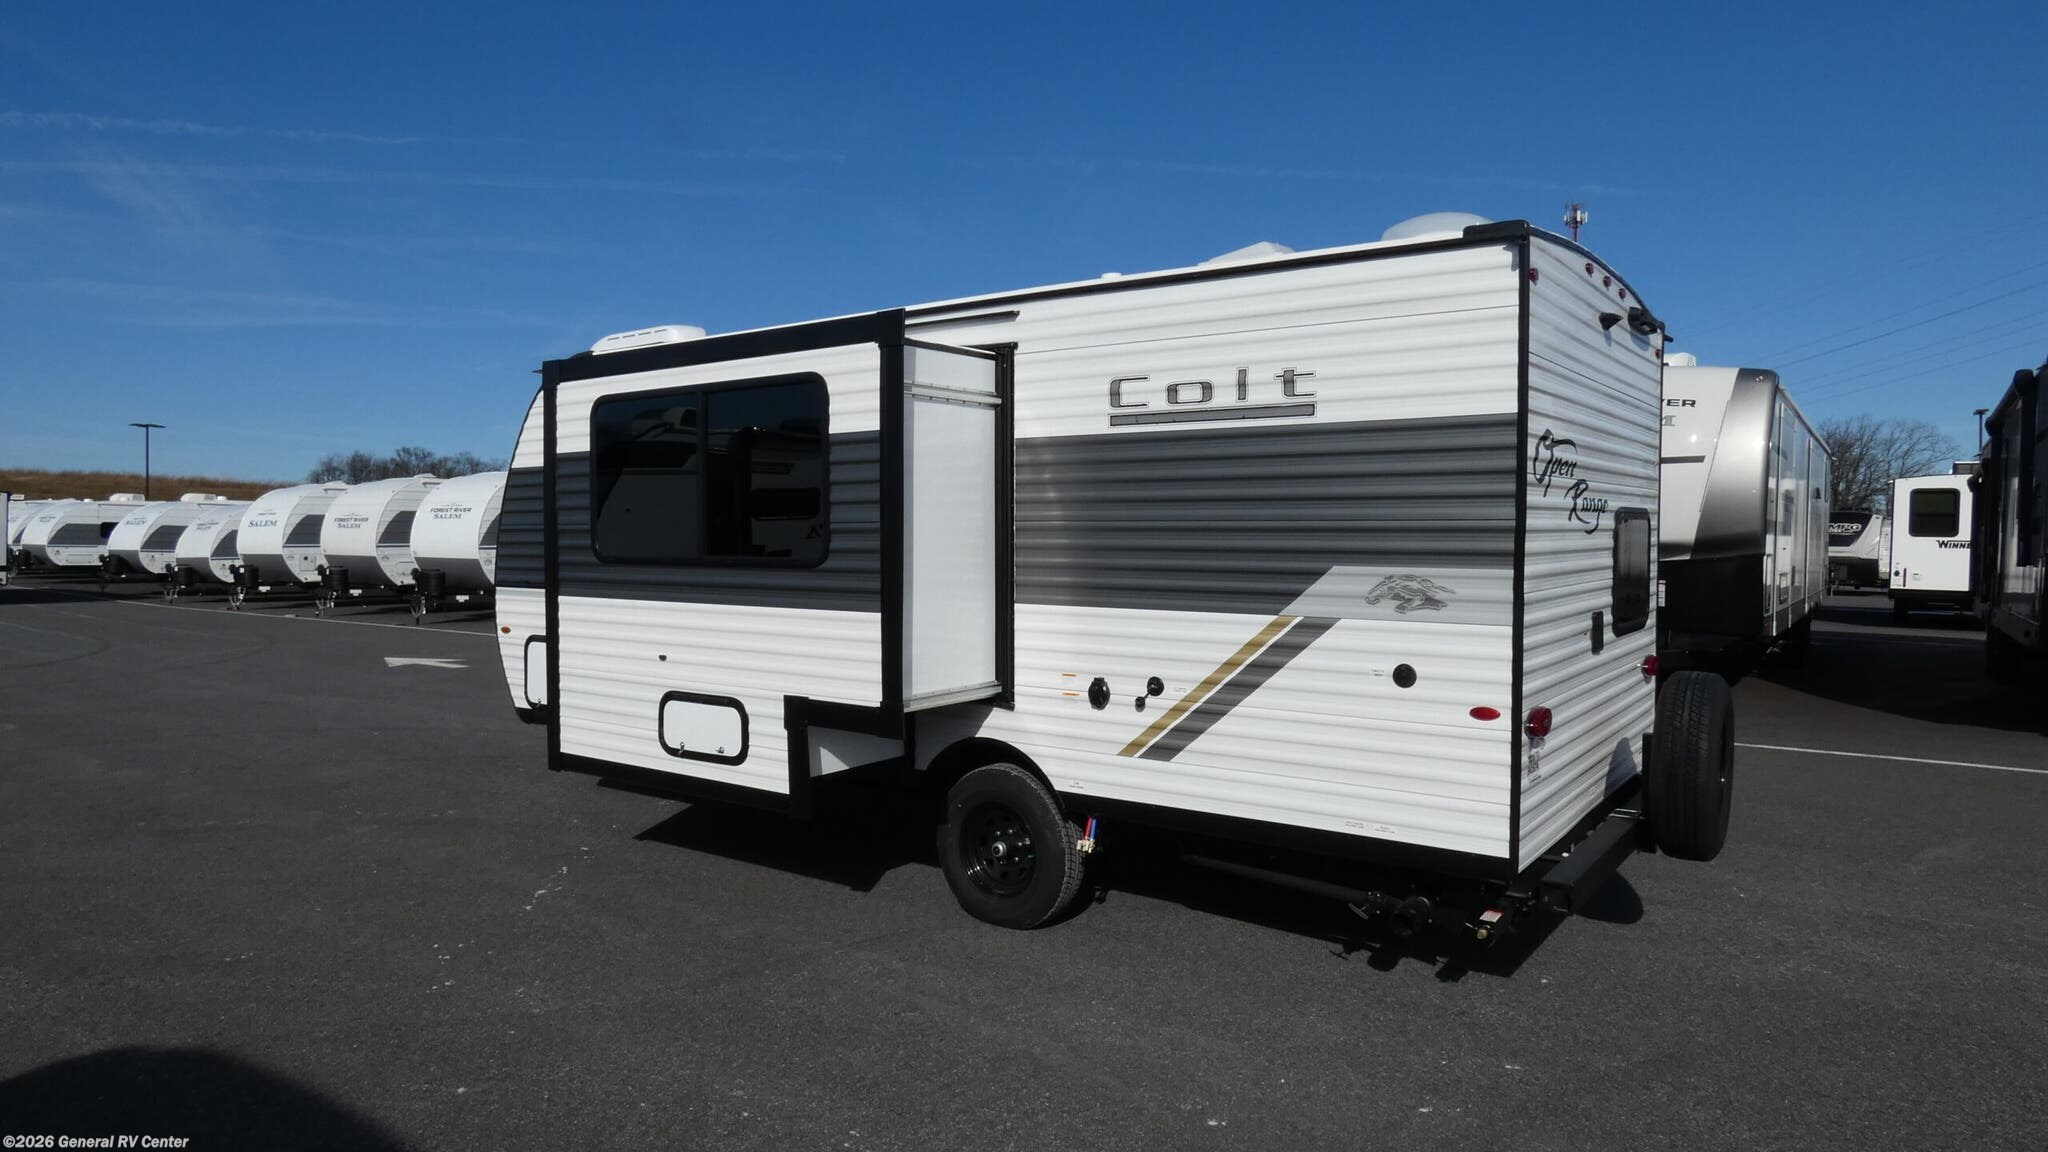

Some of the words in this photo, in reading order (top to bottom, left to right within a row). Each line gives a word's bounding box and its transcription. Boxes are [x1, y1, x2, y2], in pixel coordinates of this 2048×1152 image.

[1109, 367, 1316, 408] Colt
[1662, 398, 1696, 408] ER
[1533, 429, 1578, 498] Open
[248, 519, 278, 528] SALEM
[1564, 479, 1608, 534] Range
